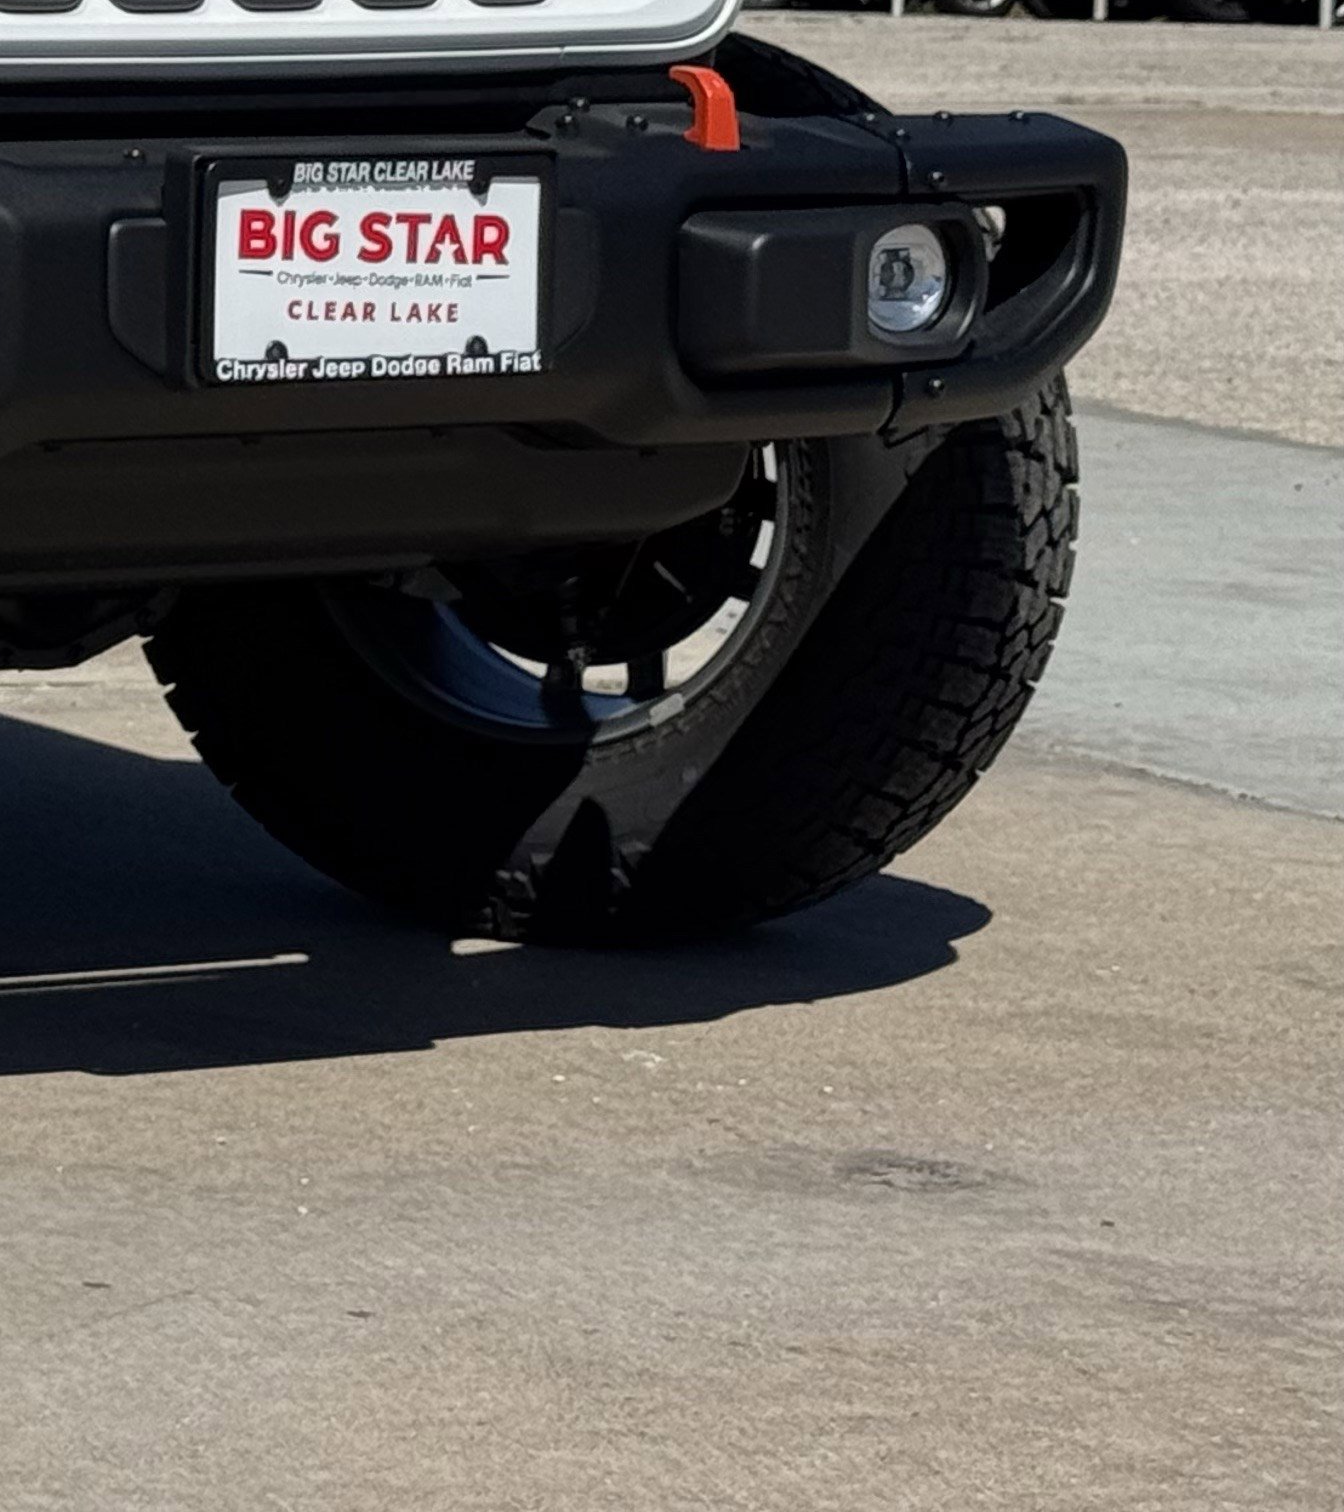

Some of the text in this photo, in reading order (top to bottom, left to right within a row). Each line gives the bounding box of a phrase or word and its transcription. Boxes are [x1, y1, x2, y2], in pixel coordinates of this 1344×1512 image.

[293, 160, 475, 183] BIG STAR CLEAR LAKE
[238, 208, 510, 266] BIG STAR
[287, 300, 459, 323] CLEAR LAKE
[216, 349, 543, 382] Chrysler Jeep Dodge Ram Fiat
